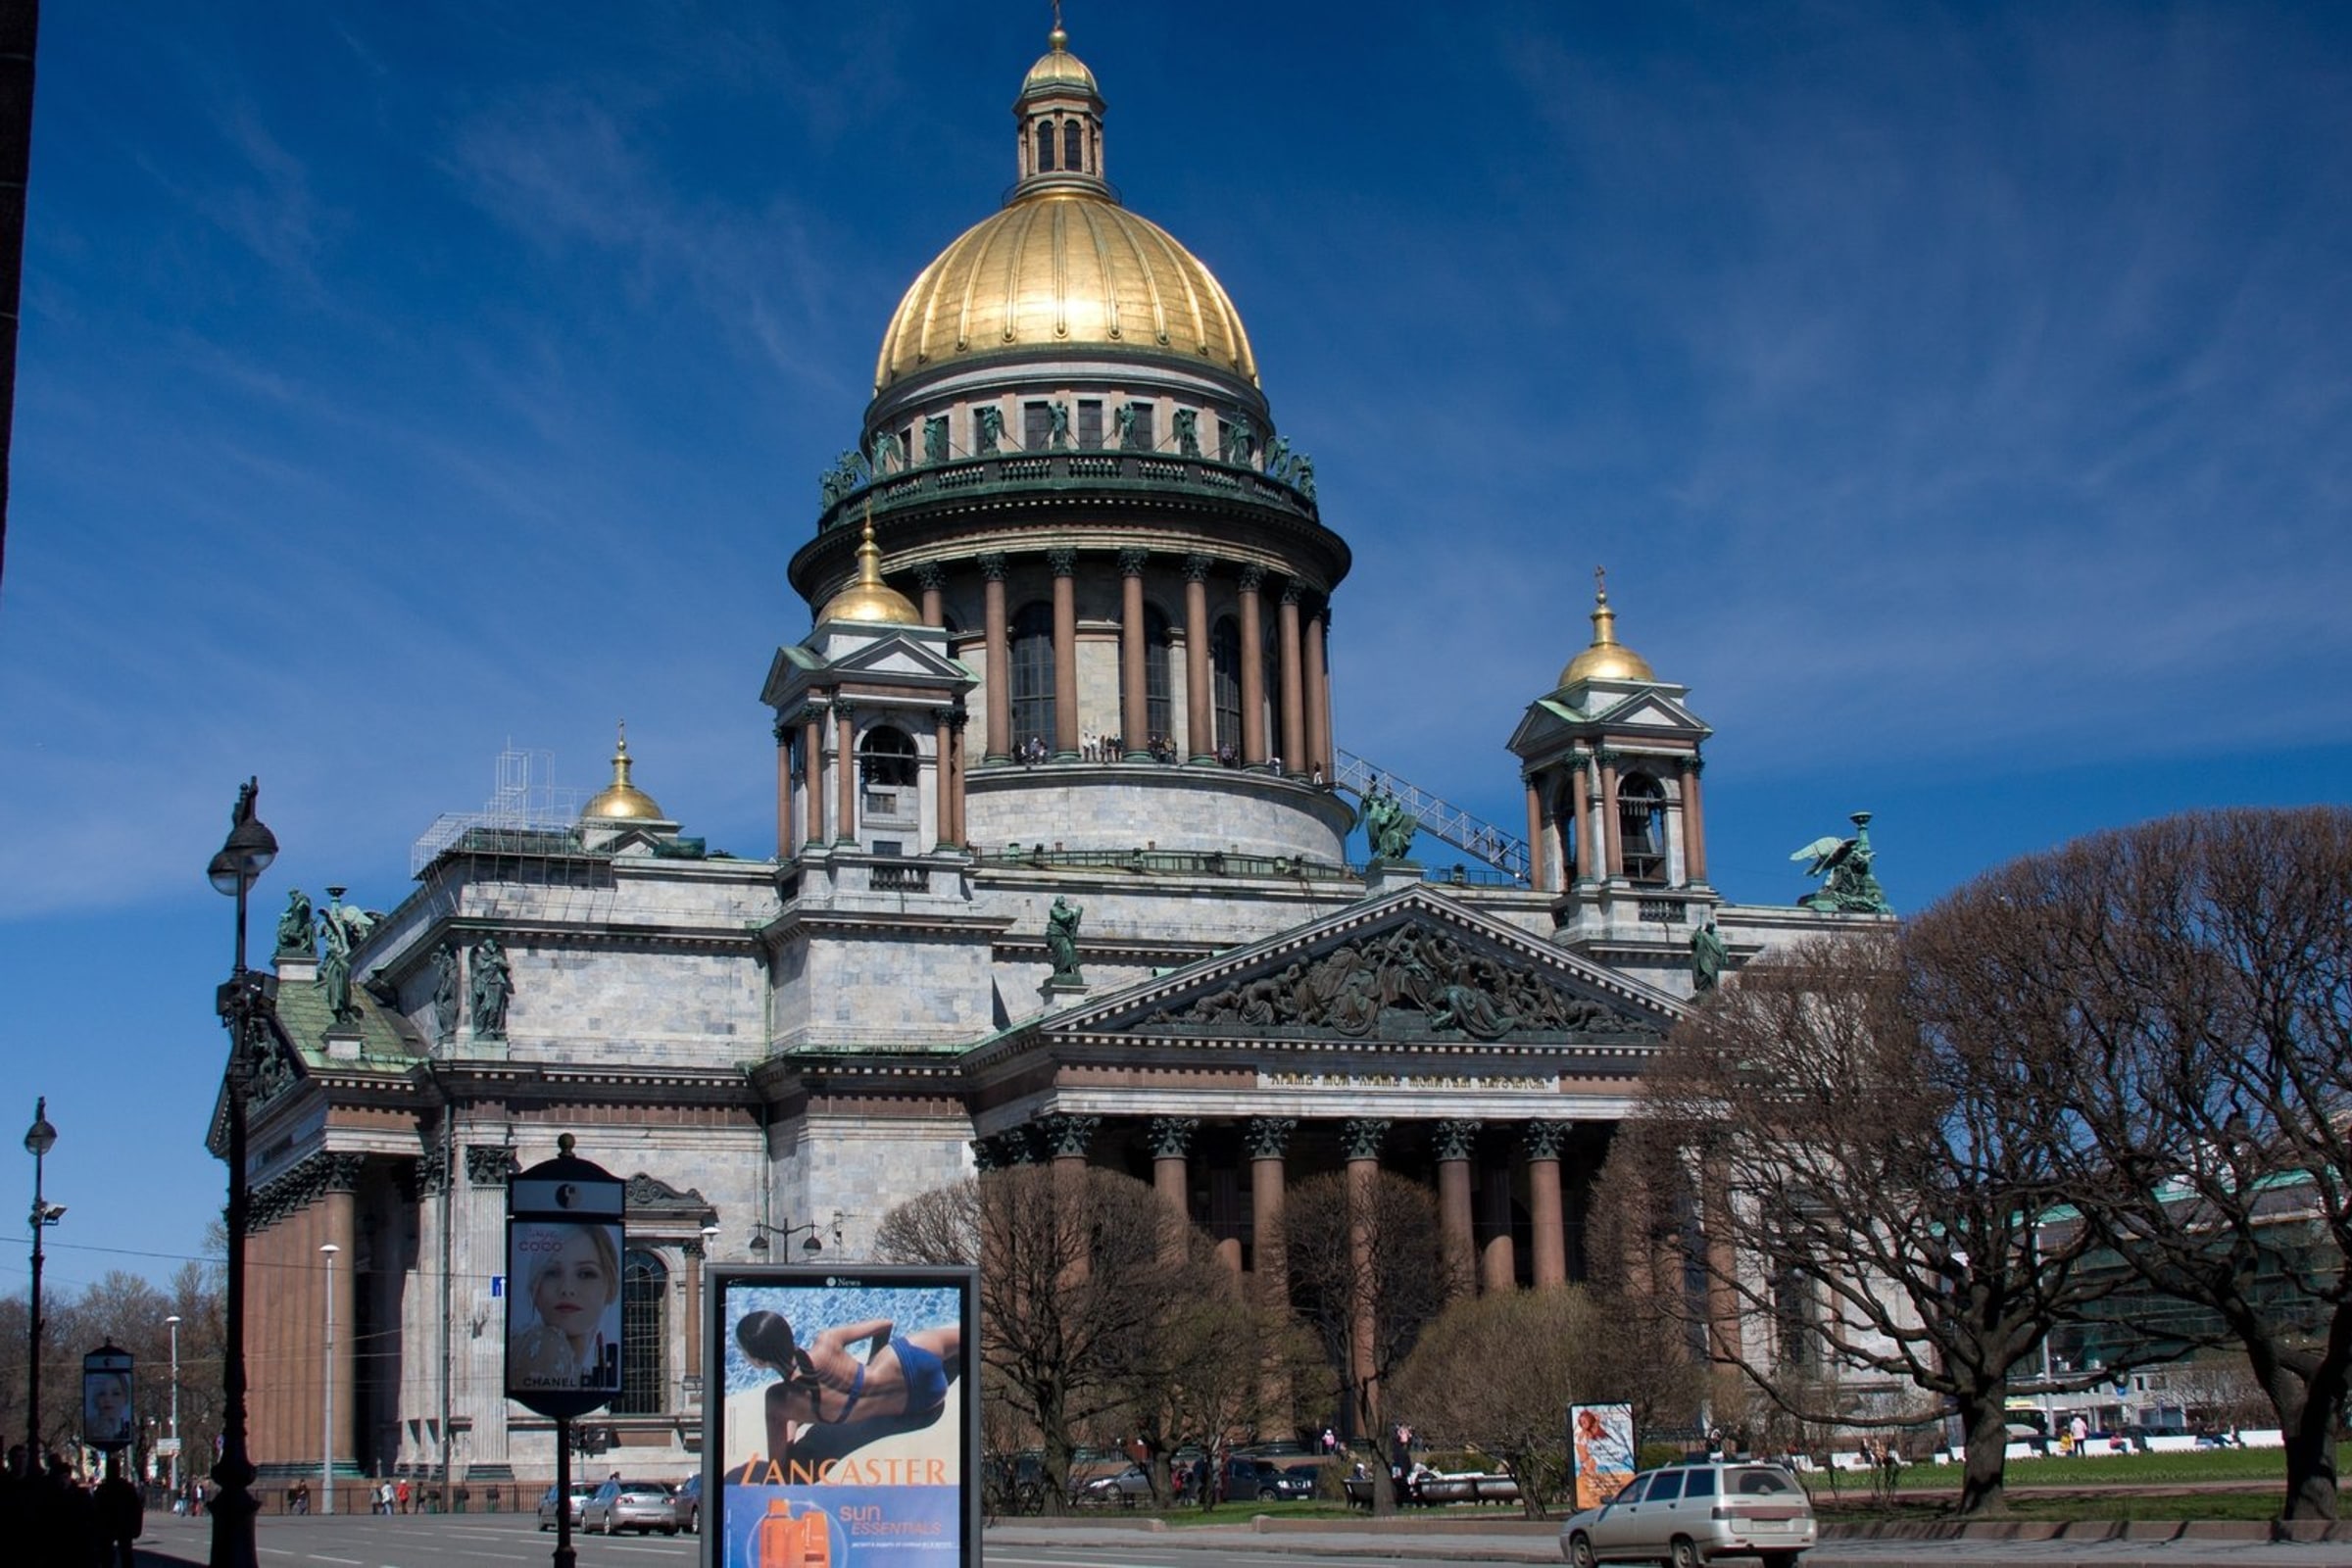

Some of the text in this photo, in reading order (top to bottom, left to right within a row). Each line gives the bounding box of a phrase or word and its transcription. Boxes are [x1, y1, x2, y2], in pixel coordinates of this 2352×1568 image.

[517, 1241, 564, 1252] COCO
[522, 1376, 577, 1389] CHANEL
[740, 1452, 947, 1487] LANCASTER
[840, 1504, 881, 1522] sun
[851, 1521, 942, 1536] ESSENTIALS
